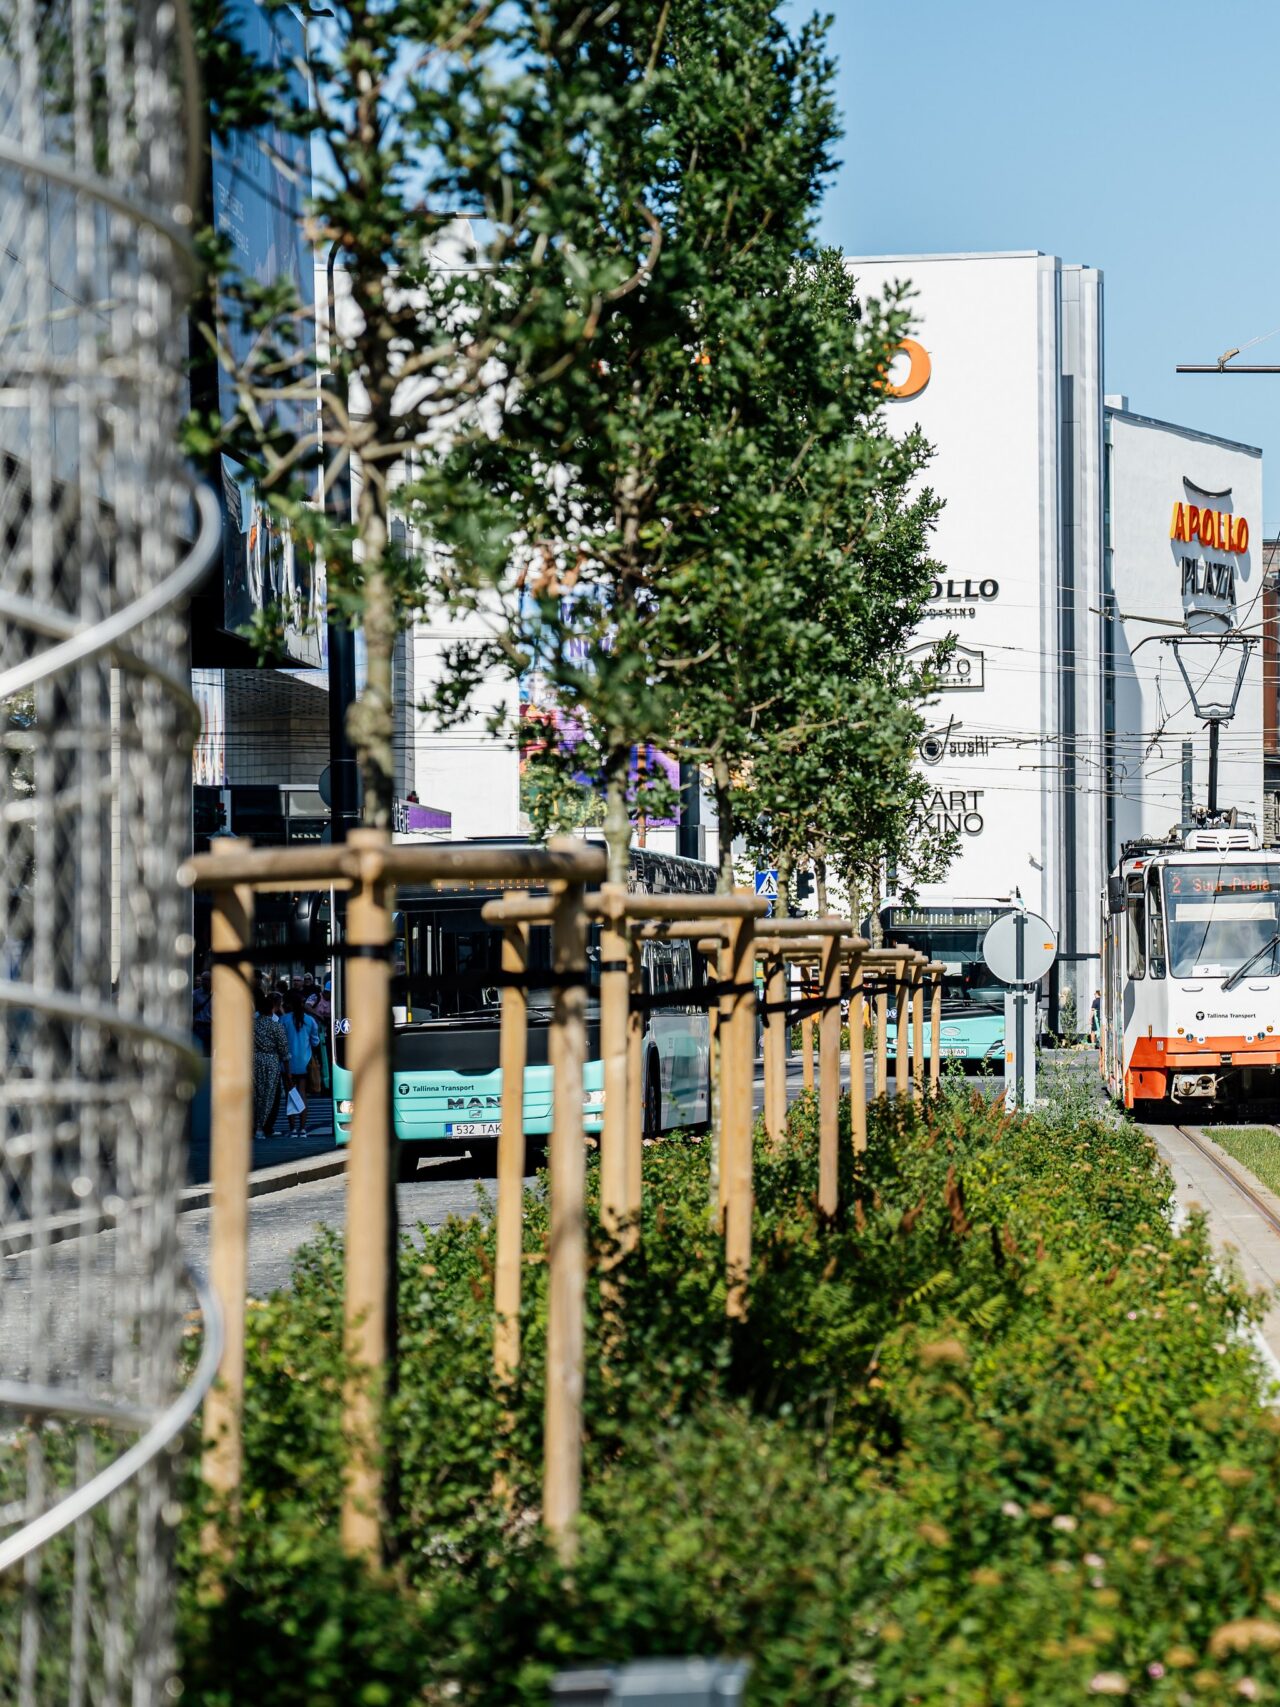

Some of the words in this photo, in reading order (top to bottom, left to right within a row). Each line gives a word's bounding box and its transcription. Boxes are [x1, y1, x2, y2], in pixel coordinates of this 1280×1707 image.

[1169, 501, 1250, 554] APOLLO
[928, 578, 1000, 599] OLLO
[1181, 556, 1237, 606] PLAZA
[950, 735, 989, 755] sushi
[1171, 876, 1182, 894] 2
[441, 1084, 475, 1092] Transport
[447, 1096, 502, 1110] MAN
[456, 1124, 475, 1135] 532
[481, 1123, 503, 1134] TAK
